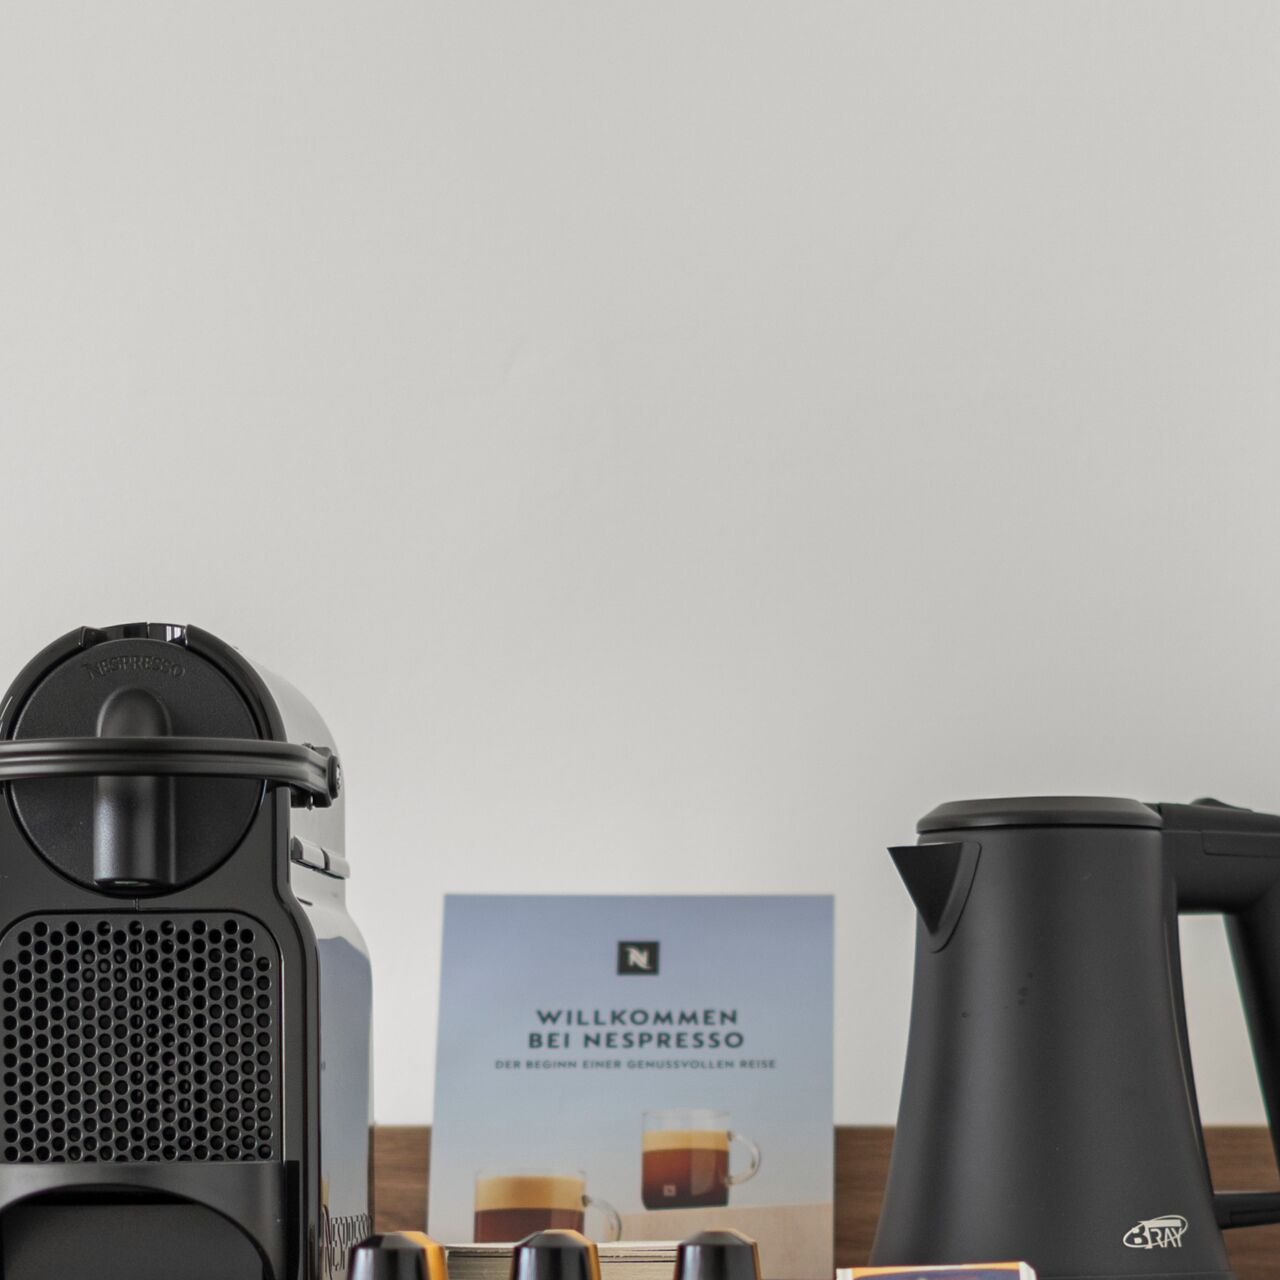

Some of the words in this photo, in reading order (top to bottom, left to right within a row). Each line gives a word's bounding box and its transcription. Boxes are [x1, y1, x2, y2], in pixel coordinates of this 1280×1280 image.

[84, 655, 186, 680] NESPRESSO
[536, 1009, 738, 1026] WILLKOMMEN
[528, 1032, 570, 1049] BEI
[583, 1032, 744, 1049] NESPRESSO
[495, 1059, 521, 1070] DER
[525, 1059, 577, 1070] BEGINN
[582, 1059, 621, 1070] EINER
[626, 1059, 735, 1070] GENUSSVOLLEN
[740, 1059, 776, 1070] REISE
